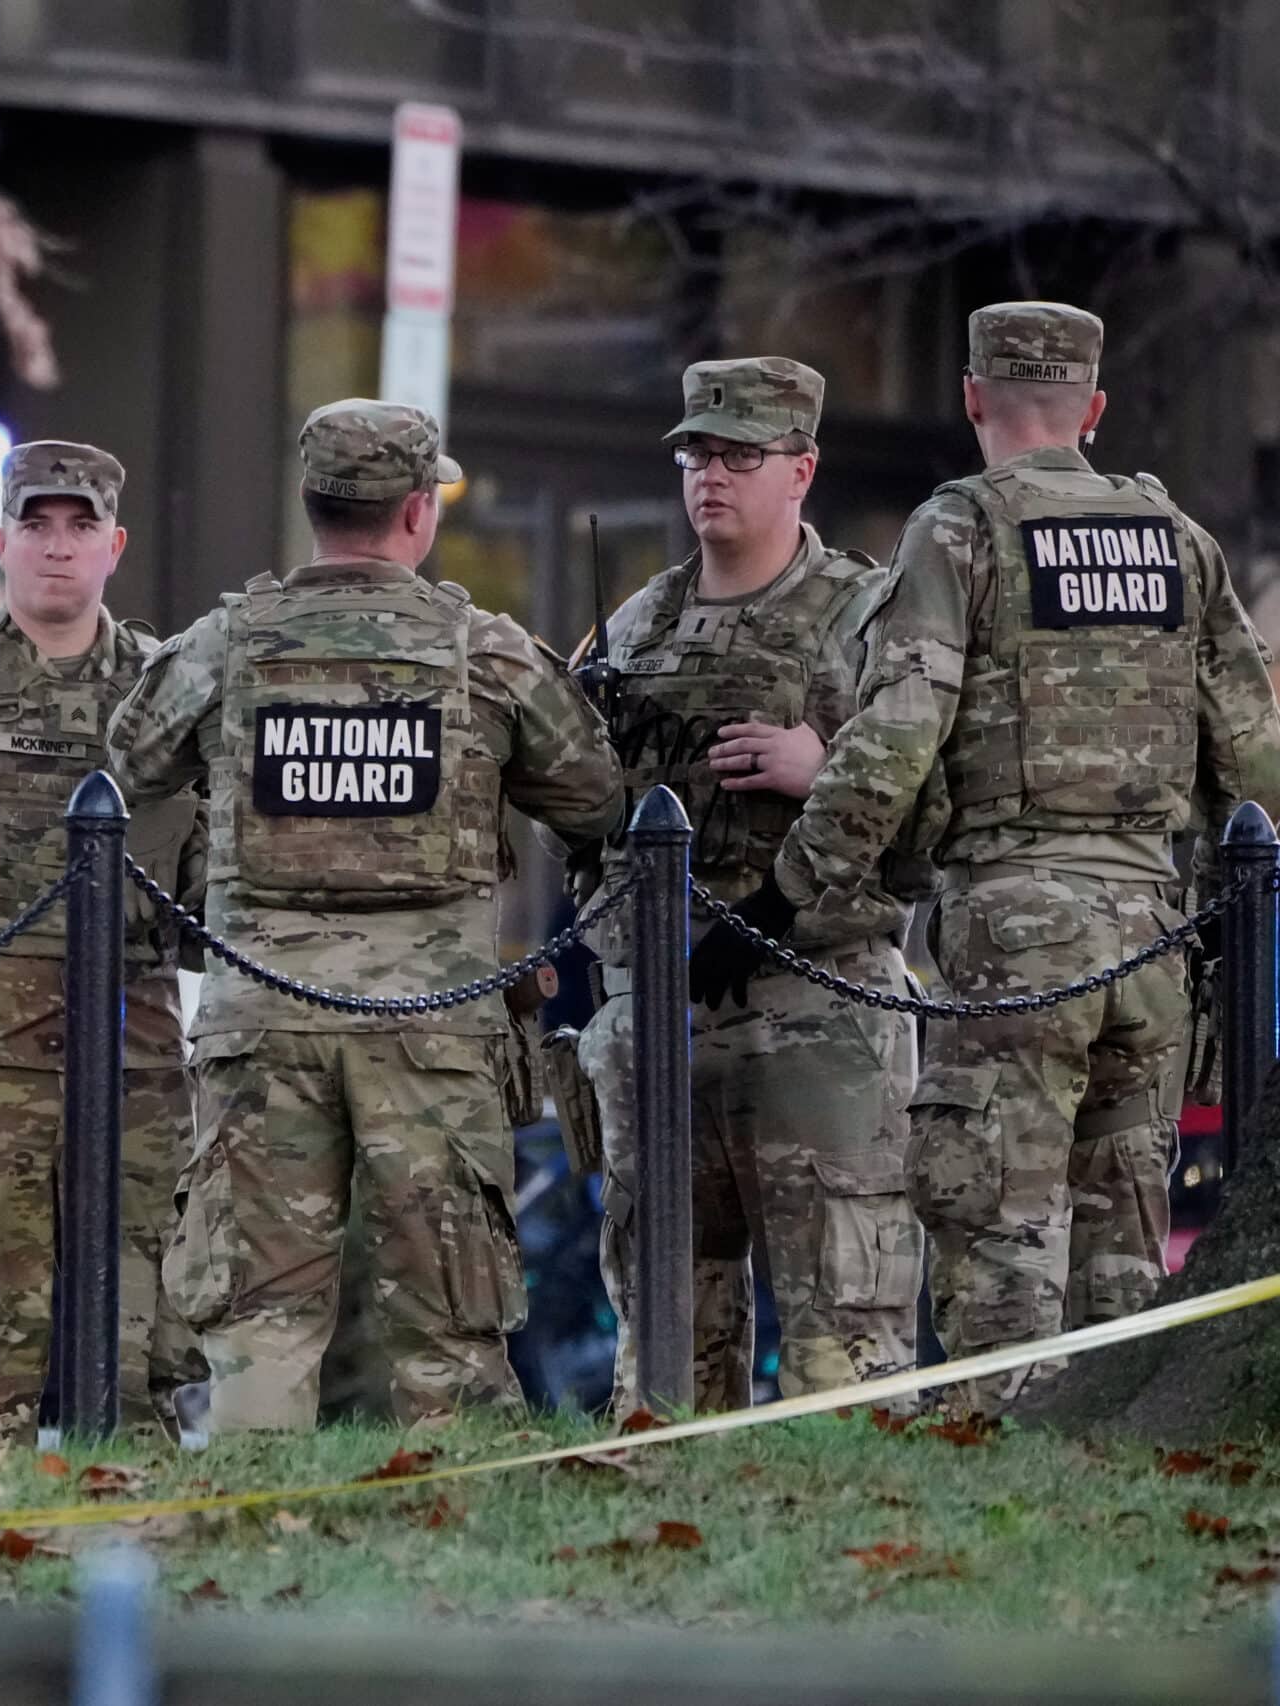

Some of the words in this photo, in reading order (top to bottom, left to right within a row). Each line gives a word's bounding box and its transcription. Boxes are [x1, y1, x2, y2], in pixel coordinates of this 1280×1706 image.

[1009, 362, 1067, 380] CONRATH
[319, 478, 358, 497] DAVIS
[1033, 528, 1178, 568] NATIONAL
[1058, 573, 1168, 613] GUARD
[11, 736, 73, 754] MCKINNEY
[263, 717, 434, 759] NATIONAL
[281, 761, 414, 803] GUARD
